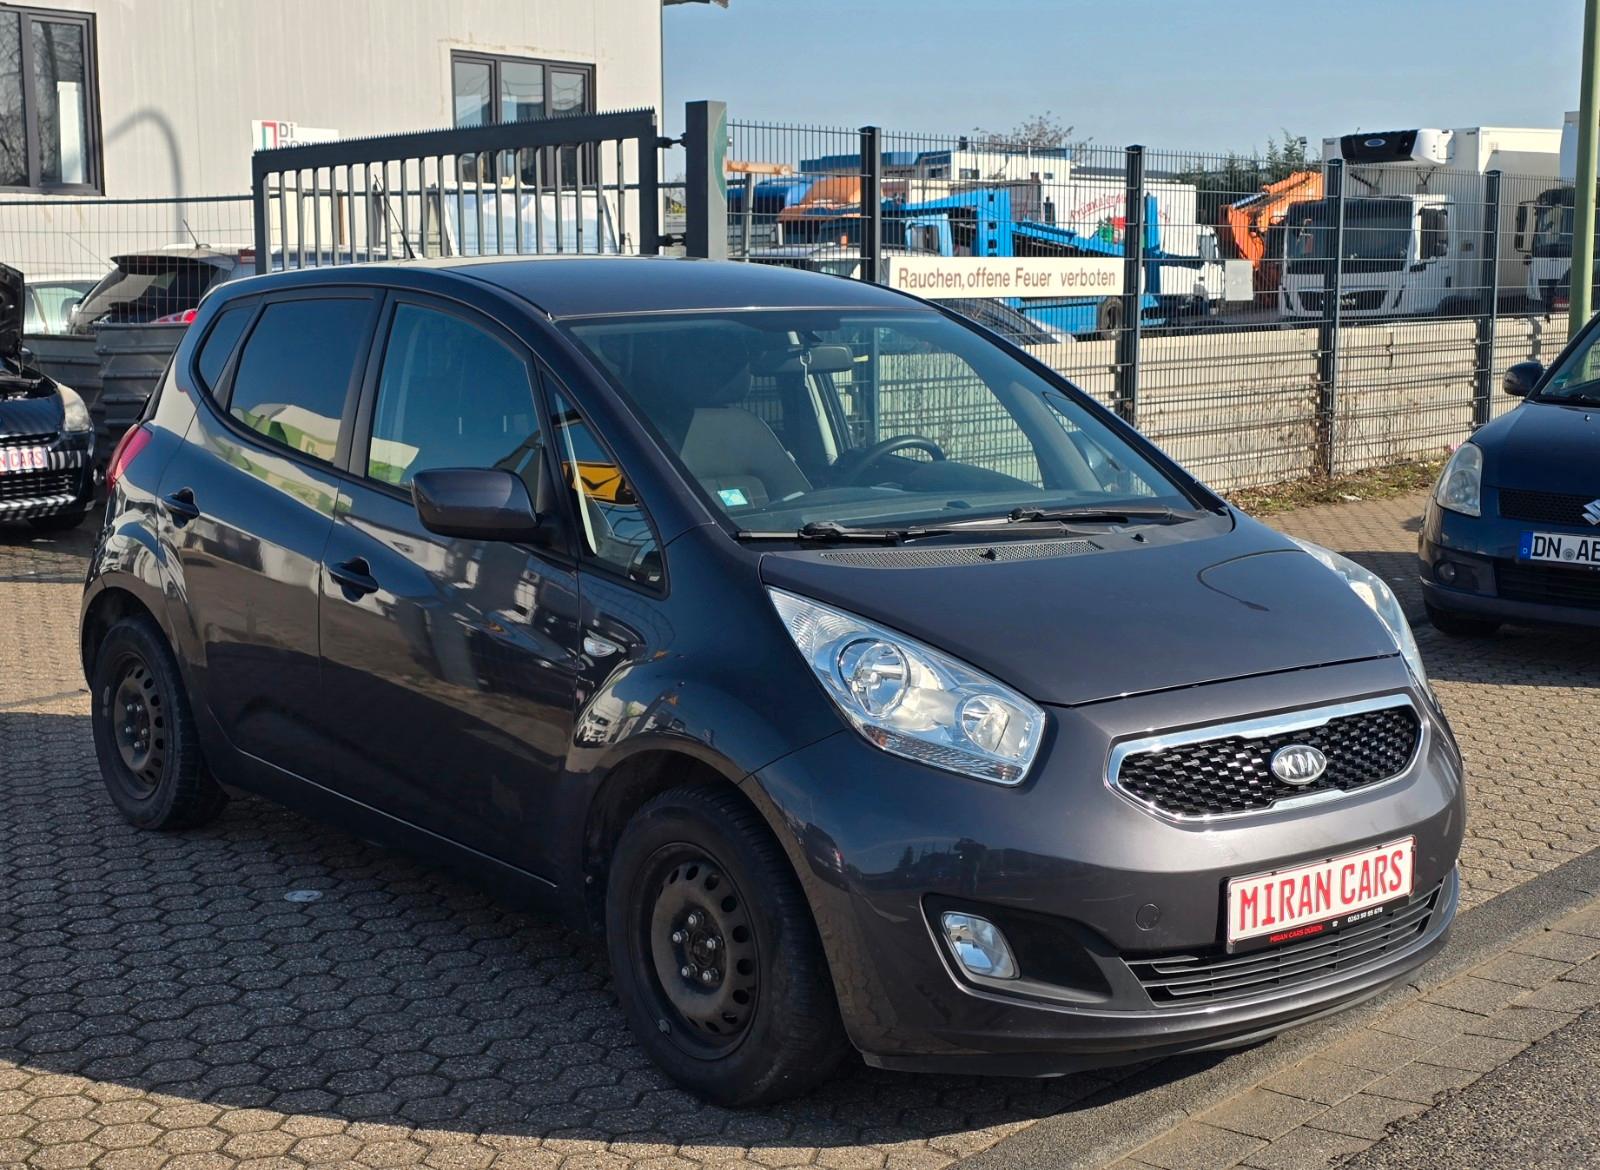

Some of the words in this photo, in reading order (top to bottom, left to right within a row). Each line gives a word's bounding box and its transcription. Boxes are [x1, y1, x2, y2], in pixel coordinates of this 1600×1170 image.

[279, 123, 294, 139] Di
[898, 267, 964, 290] Rauchen,
[967, 266, 1011, 288] offene
[1014, 266, 1052, 288] Feuer
[1060, 267, 1116, 288] verboten
[10, 451, 43, 467] CARS
[1532, 536, 1562, 558] DN
[1280, 751, 1320, 776] KIA
[1239, 869, 1331, 931] MIRAN
[1340, 849, 1404, 905] CARS
